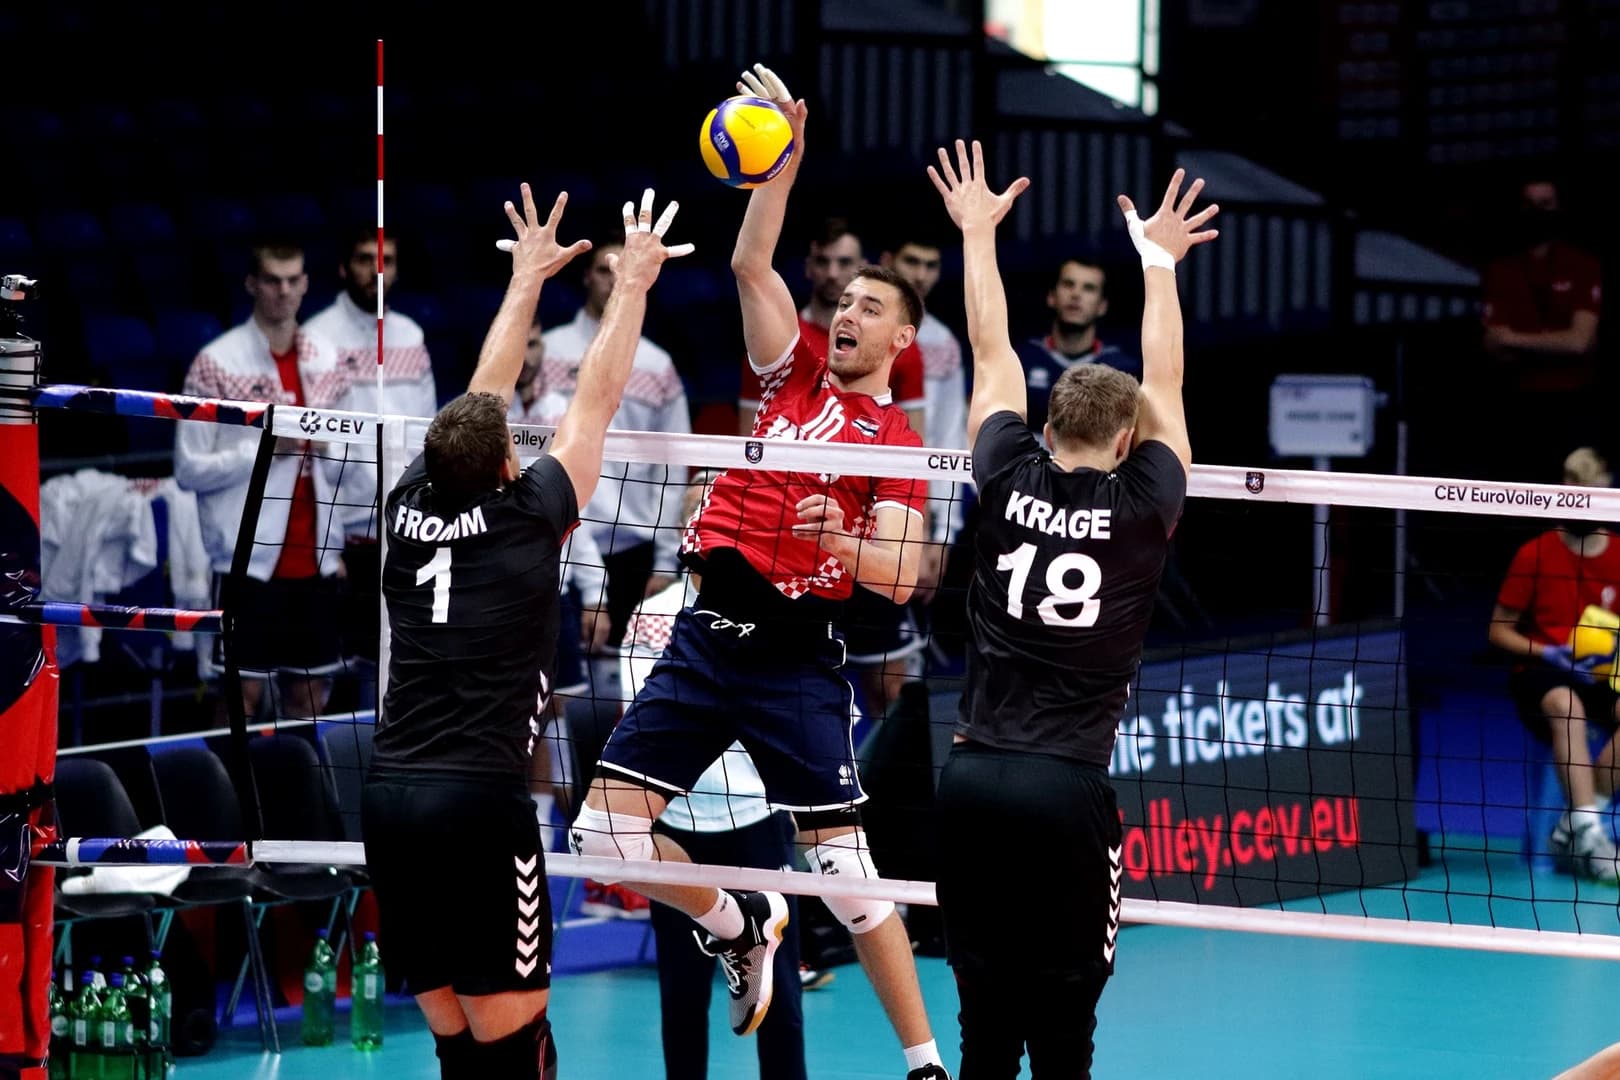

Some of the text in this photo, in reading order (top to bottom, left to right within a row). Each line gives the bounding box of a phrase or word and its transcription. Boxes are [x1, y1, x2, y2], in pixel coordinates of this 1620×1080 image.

[326, 417, 364, 435] CEV
[513, 430, 547, 450] olley
[928, 454, 960, 470] CEV
[1004, 489, 1112, 540] KRAGE
[1434, 485, 1591, 510] CEV EuroVolley 2021
[394, 504, 488, 542] FROMM
[415, 546, 453, 624] 1
[995, 541, 1102, 628] 18
[1162, 679, 1308, 766] tickets
[1315, 671, 1363, 744] at
[1122, 797, 1360, 890] olley.cev.eu
